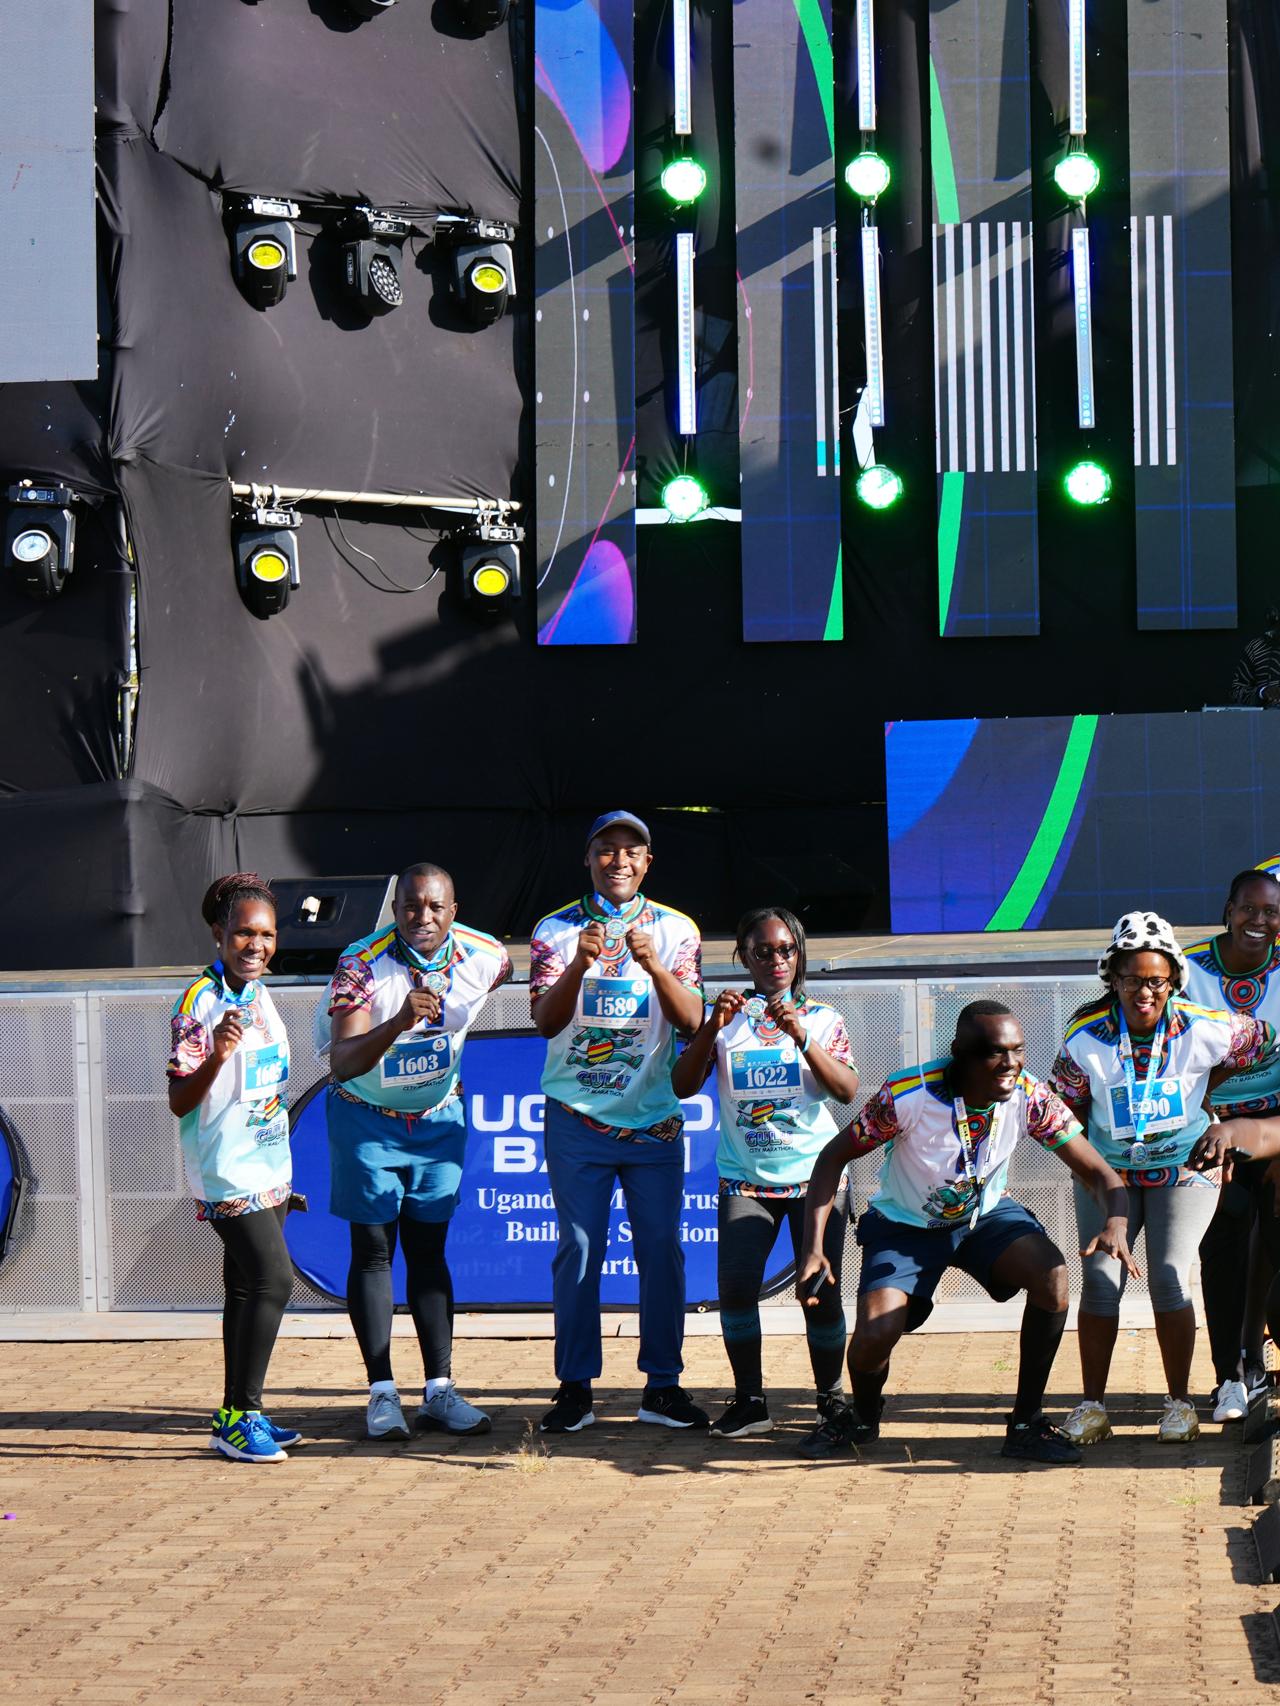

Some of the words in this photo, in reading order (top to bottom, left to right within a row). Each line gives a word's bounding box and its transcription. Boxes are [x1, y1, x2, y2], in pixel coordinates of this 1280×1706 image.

[595, 996, 637, 1016] 1589
[397, 1054, 439, 1075] 1603
[576, 1071, 631, 1090] GULU
[745, 1066, 788, 1088] 1622
